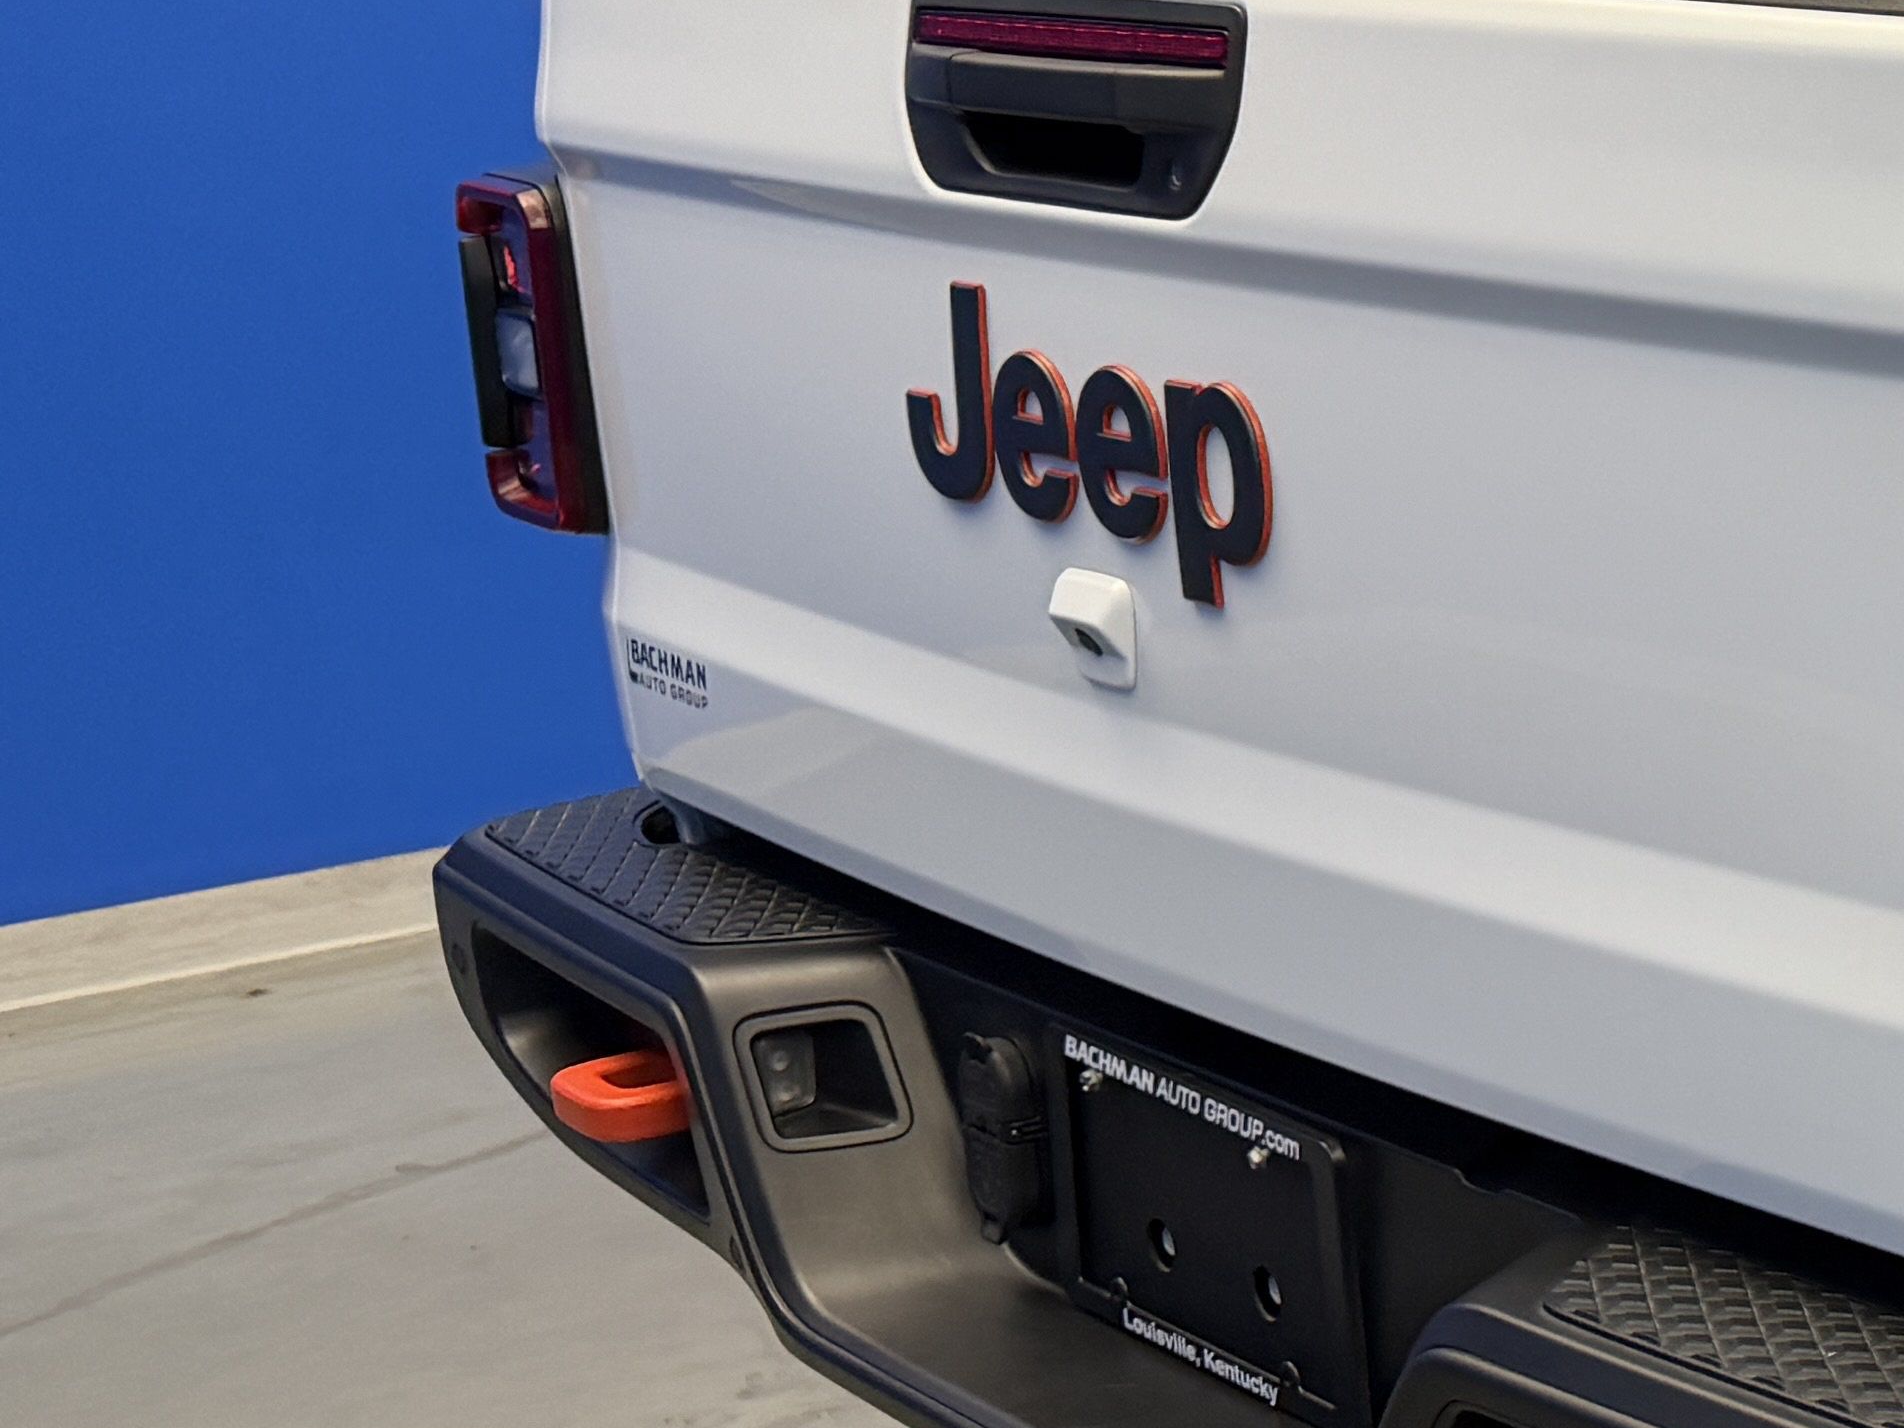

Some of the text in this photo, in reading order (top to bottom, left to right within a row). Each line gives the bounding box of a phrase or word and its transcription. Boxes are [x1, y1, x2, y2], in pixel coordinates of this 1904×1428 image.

[905, 280, 1273, 608] Jeep
[631, 638, 707, 691] BACHMAN
[639, 673, 708, 709] AUTO GROUP
[1064, 1034, 1300, 1160] BACHMAN AUTO GROUP.com
[1122, 1307, 1279, 1407] Louisville, Kentucky
